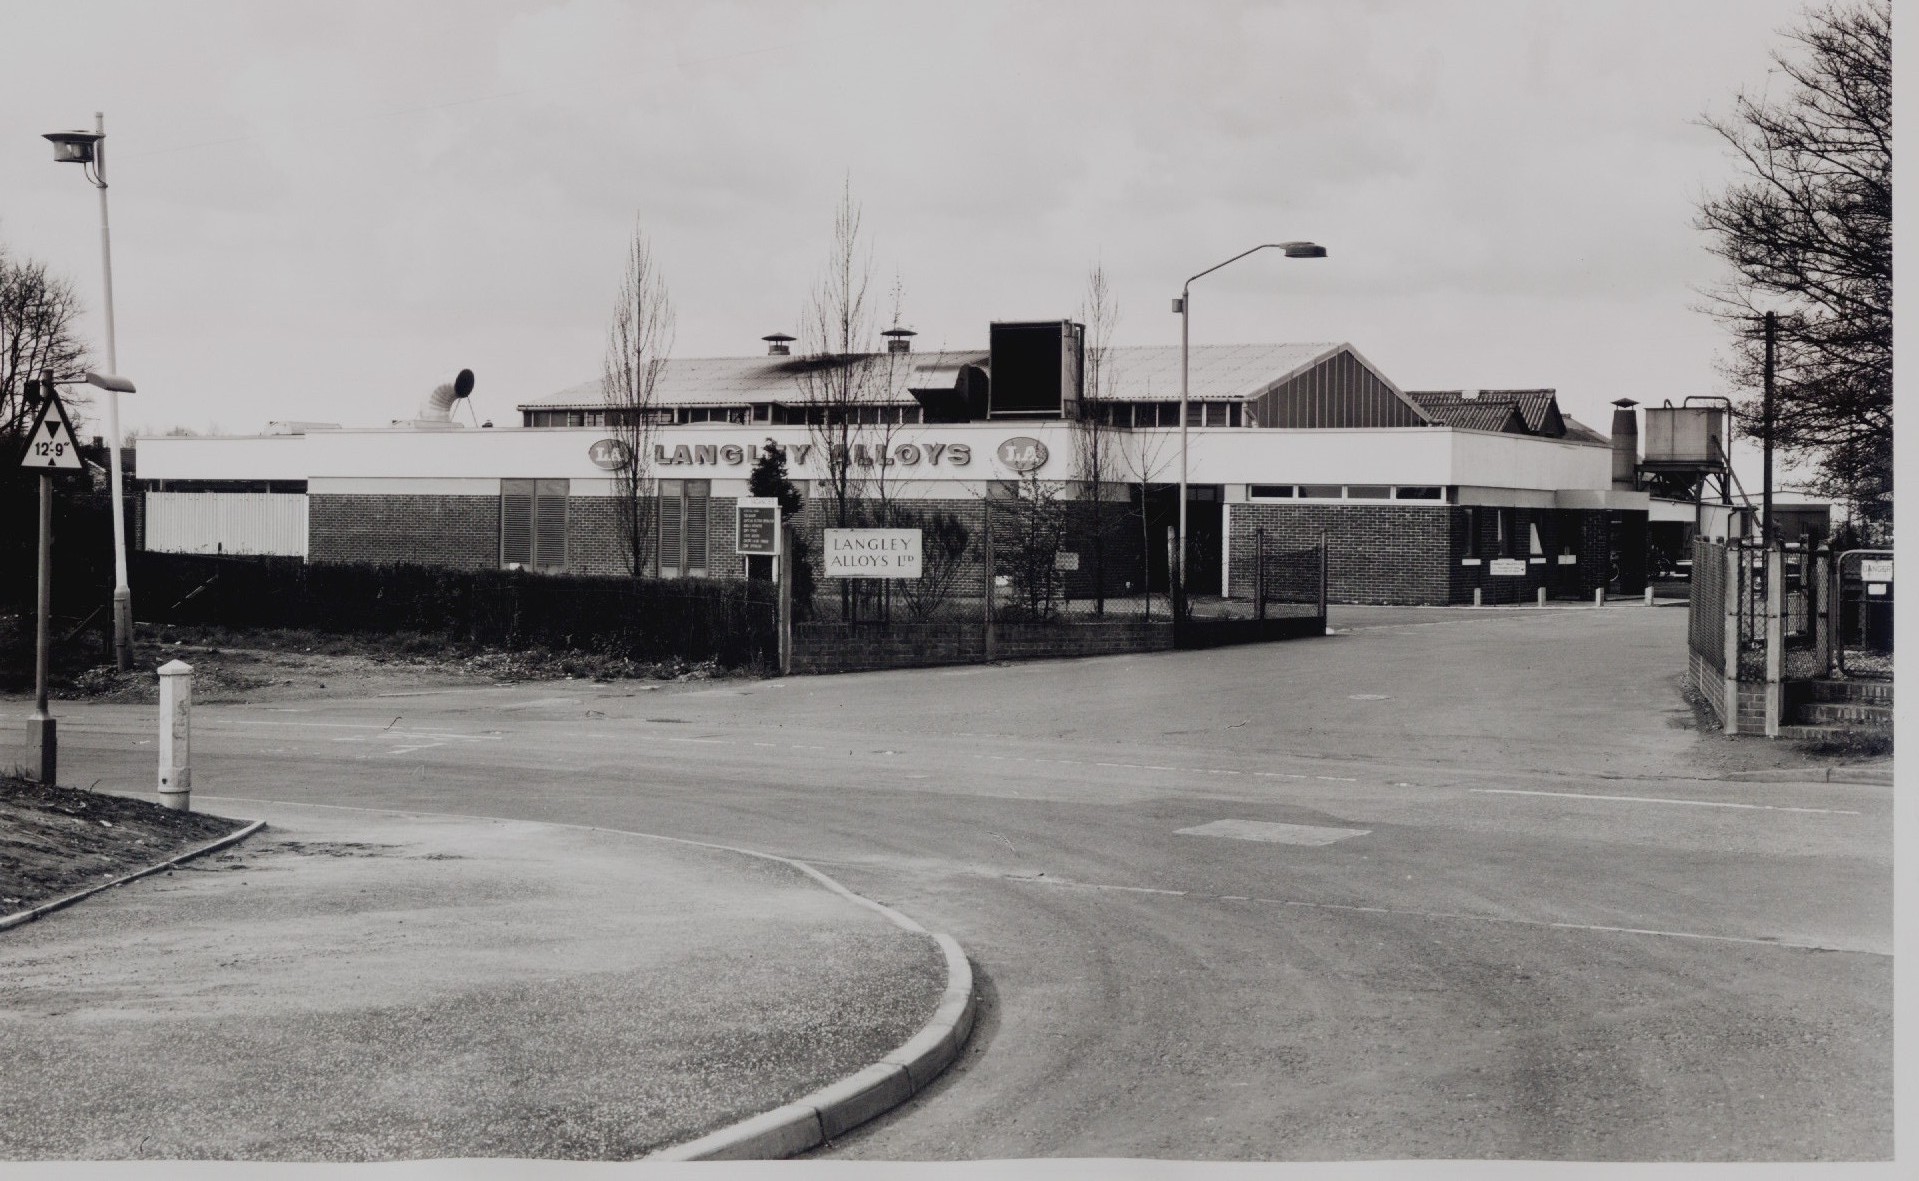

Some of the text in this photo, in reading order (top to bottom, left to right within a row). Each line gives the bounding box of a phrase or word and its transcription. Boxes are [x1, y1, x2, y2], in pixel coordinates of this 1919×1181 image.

[596, 447, 623, 462] LA
[830, 443, 971, 466] ALLOYS
[1005, 445, 1040, 462] LA
[834, 538, 911, 551] LANGLEY
[831, 555, 889, 567] ALLOYS
